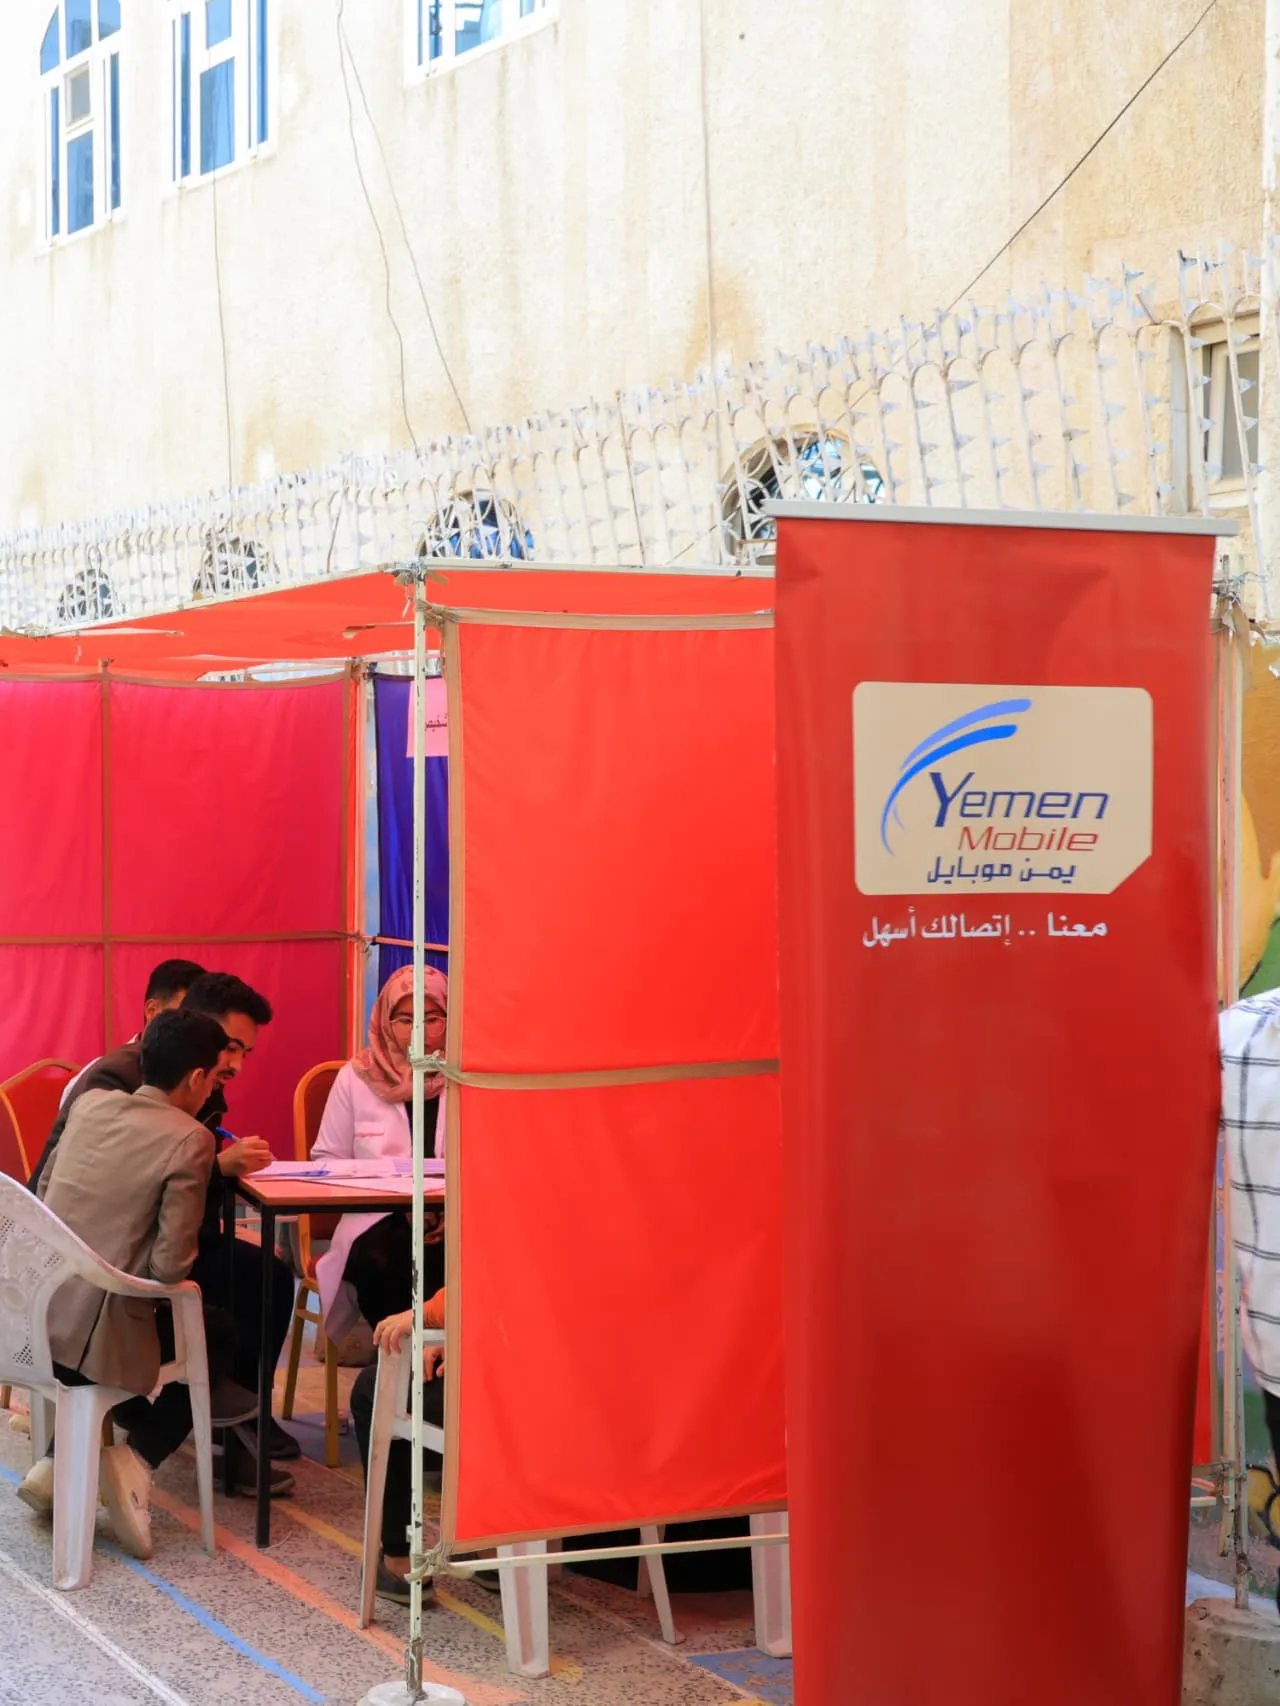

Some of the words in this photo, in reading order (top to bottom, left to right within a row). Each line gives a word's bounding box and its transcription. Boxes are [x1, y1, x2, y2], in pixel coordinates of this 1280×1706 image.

[928, 771, 1110, 828] Yemen
[957, 826, 1099, 852] Mobile
[926, 856, 1013, 885] موبايل
[1019, 857, 1077, 884] يمن
[862, 906, 917, 948] أسهل
[921, 912, 1013, 947] إتصالك
[1046, 912, 1109, 937] معنا
